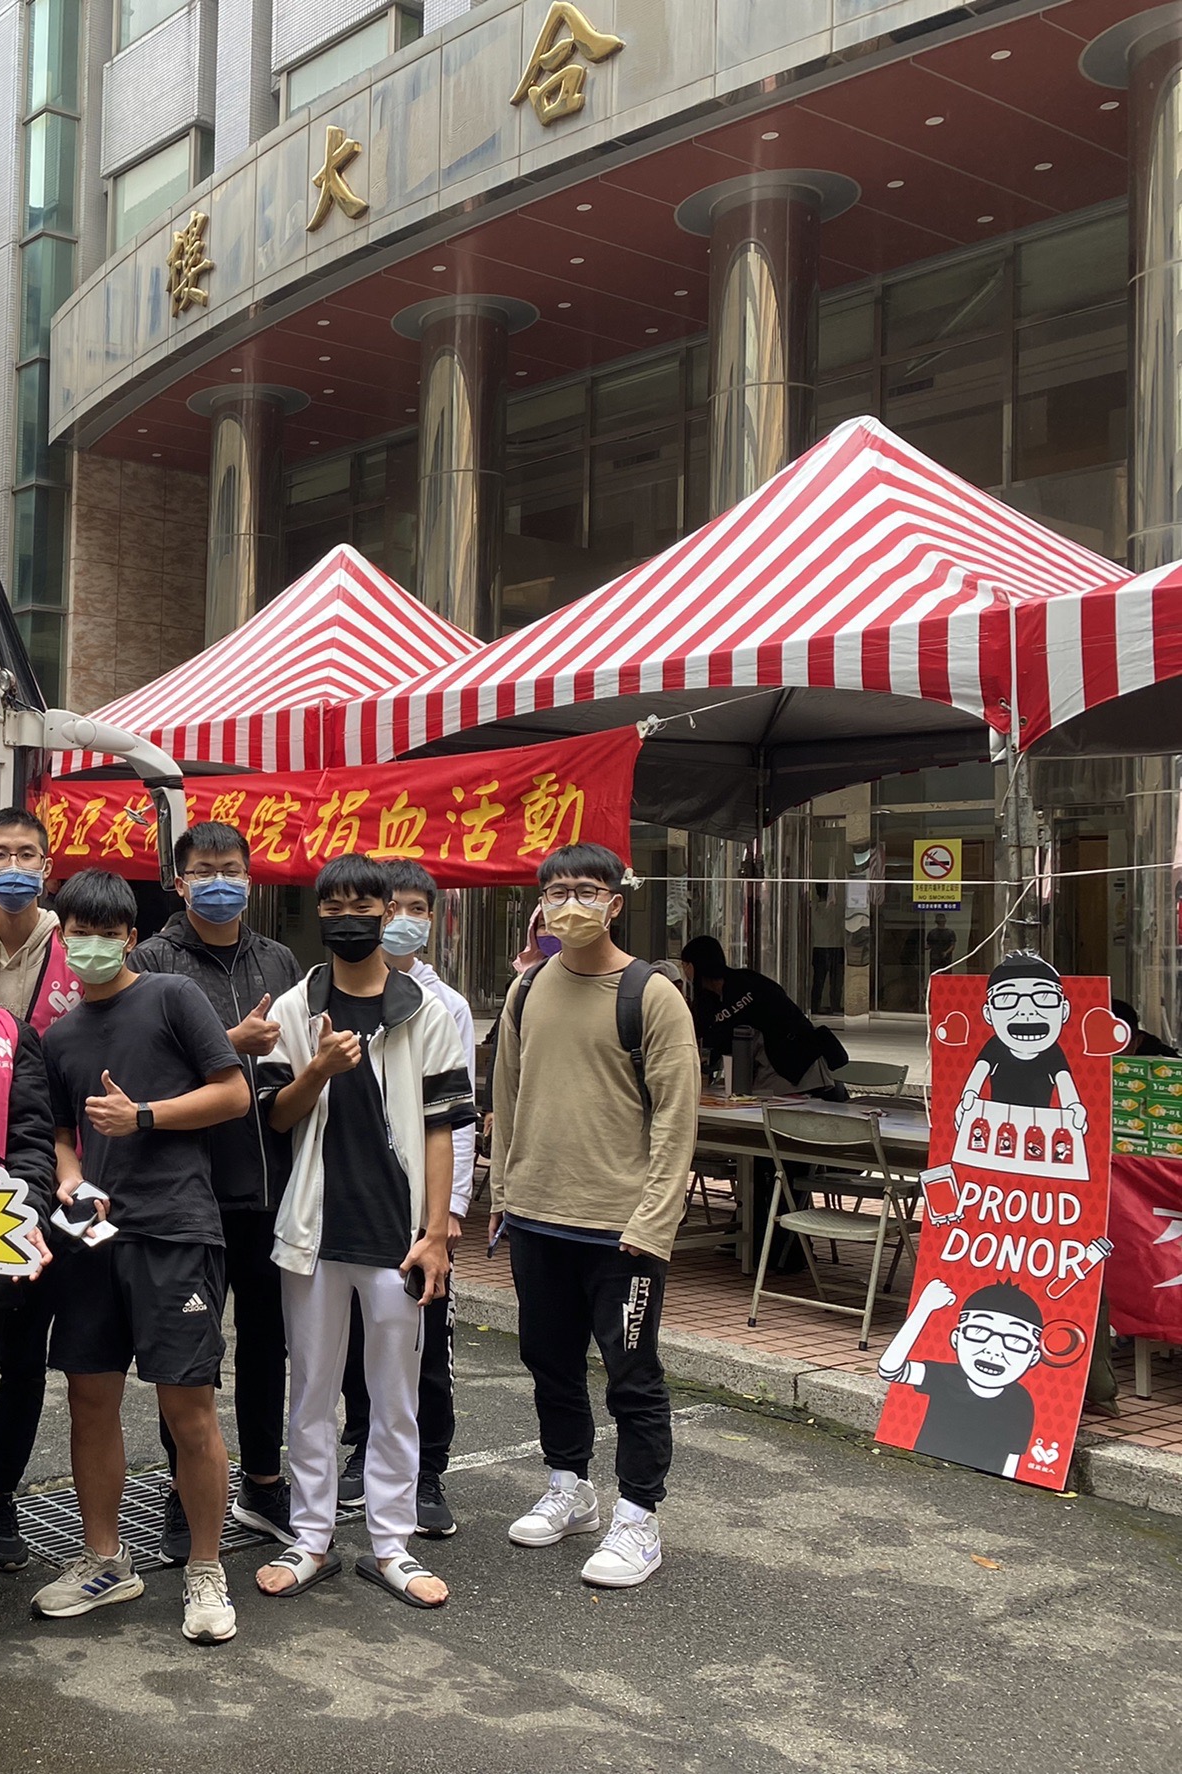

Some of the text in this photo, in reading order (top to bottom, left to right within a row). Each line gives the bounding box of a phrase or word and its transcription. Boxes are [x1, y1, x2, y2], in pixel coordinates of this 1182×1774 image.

[35, 772, 585, 862] 南亞技學院捐血活動
[955, 1181, 1081, 1226] PROUD
[940, 1227, 1086, 1280] DONOR
[182, 1303, 207, 1313] adidas
[627, 1276, 651, 1349] ATTITUDE
